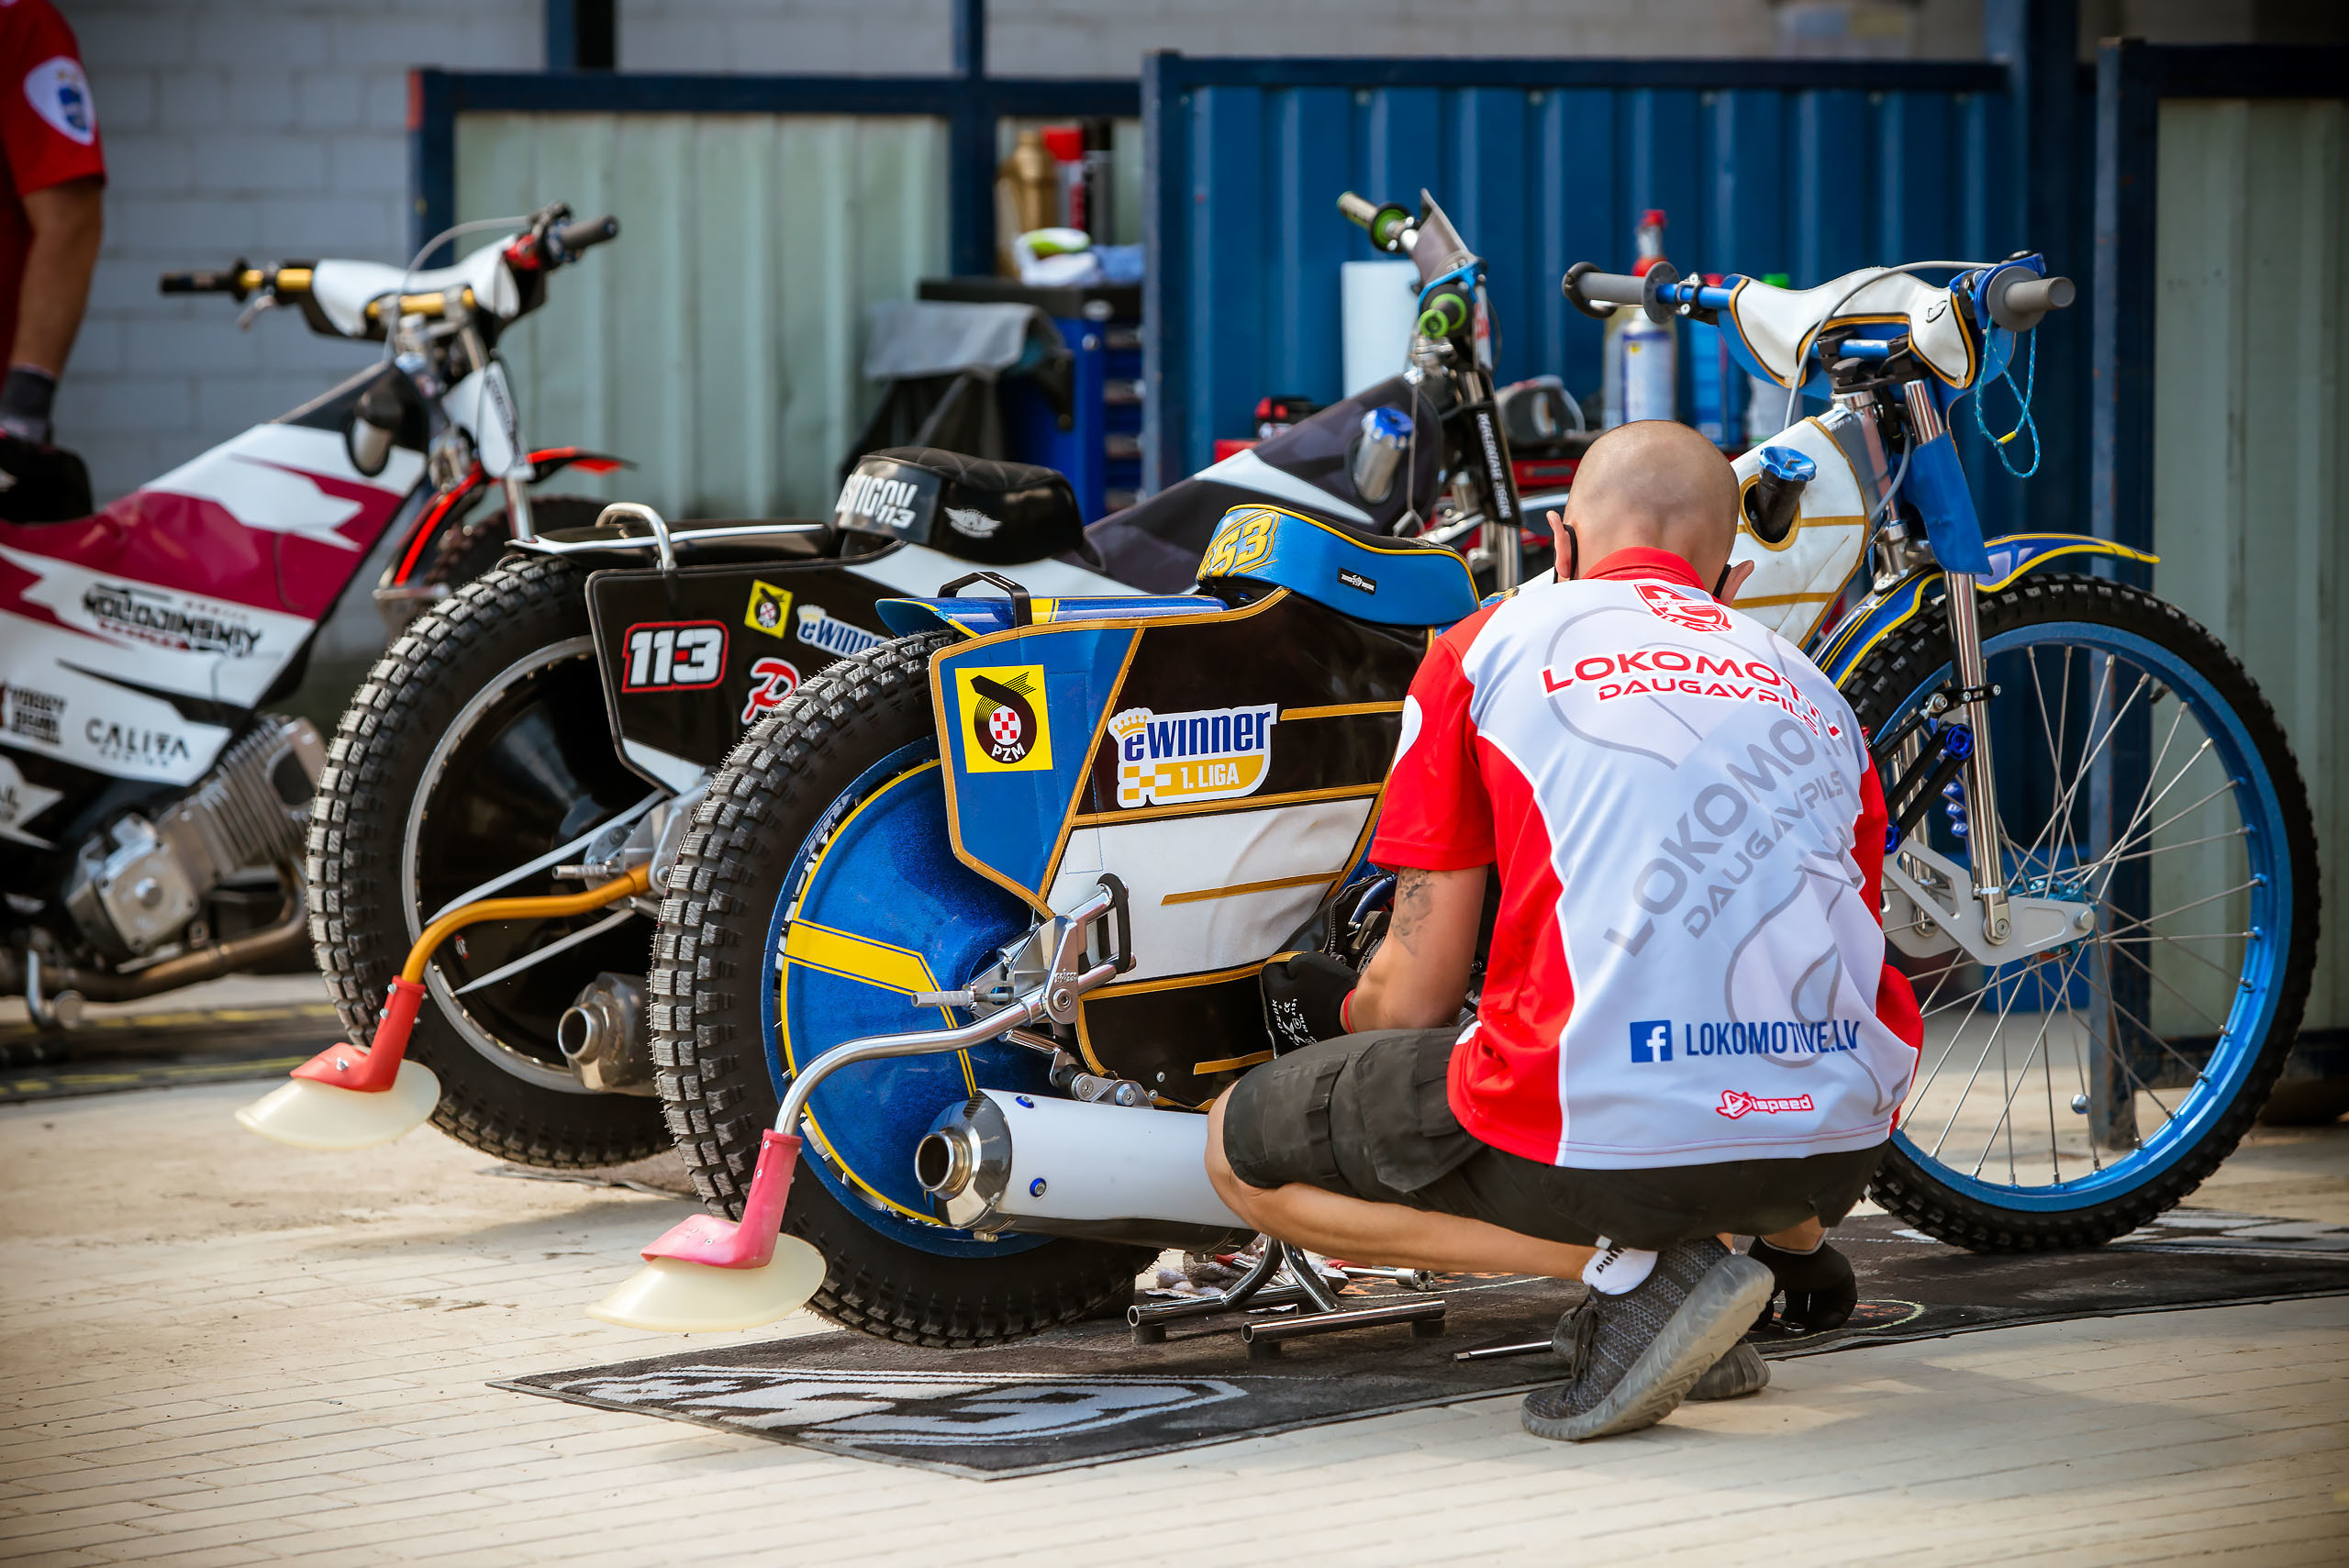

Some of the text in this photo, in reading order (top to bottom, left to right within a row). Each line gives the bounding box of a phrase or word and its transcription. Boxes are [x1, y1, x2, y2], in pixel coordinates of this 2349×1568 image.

[875, 504, 917, 529] 113
[629, 627, 723, 685] 113
[1598, 677, 1820, 738] DAUGAVPILS
[991, 742, 1026, 762] PZM
[1180, 762, 1240, 789] 1. LIGA
[1682, 770, 1844, 940] DAUGAVPILS
[1685, 1018, 1861, 1056] LOKOMOTIVE.LV
